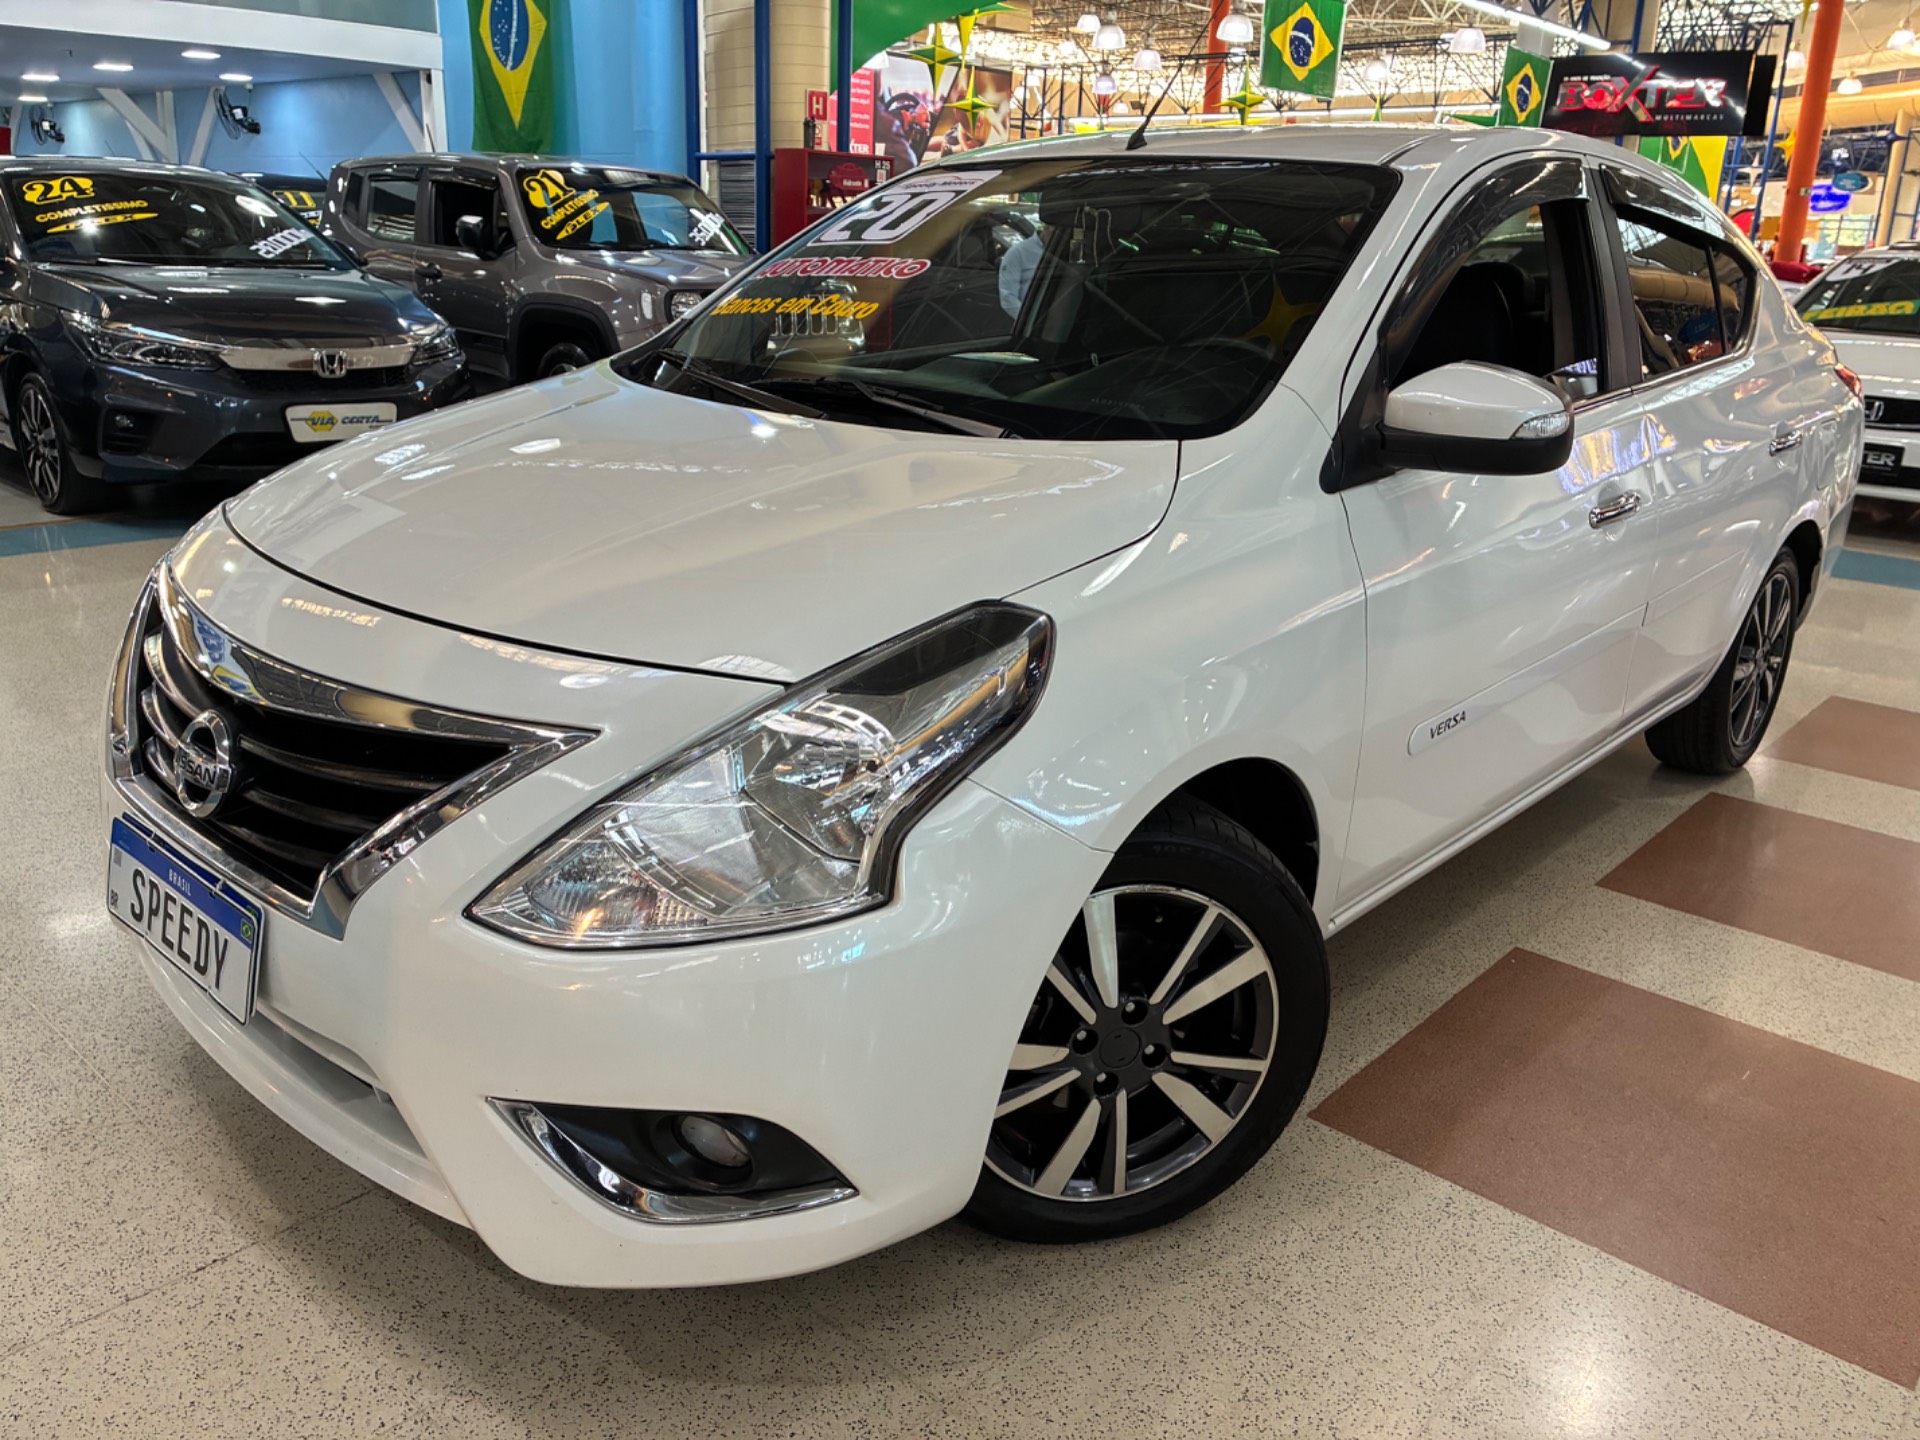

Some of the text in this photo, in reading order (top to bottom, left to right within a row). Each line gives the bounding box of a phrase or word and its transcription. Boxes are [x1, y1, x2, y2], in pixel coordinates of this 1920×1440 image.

[812, 96, 825, 116] H
[1557, 65, 1727, 122] BOXTER
[1655, 113, 1725, 121] MULTIMARCAS
[23, 176, 95, 205] 24
[523, 169, 576, 208] 21
[819, 191, 957, 242] 20
[775, 296, 814, 315] em
[808, 293, 880, 320] Couro
[310, 416, 335, 426] VIA
[1429, 710, 1467, 739] VERSA
[168, 868, 193, 897] BRASIL
[129, 867, 229, 991] SPEEDY
